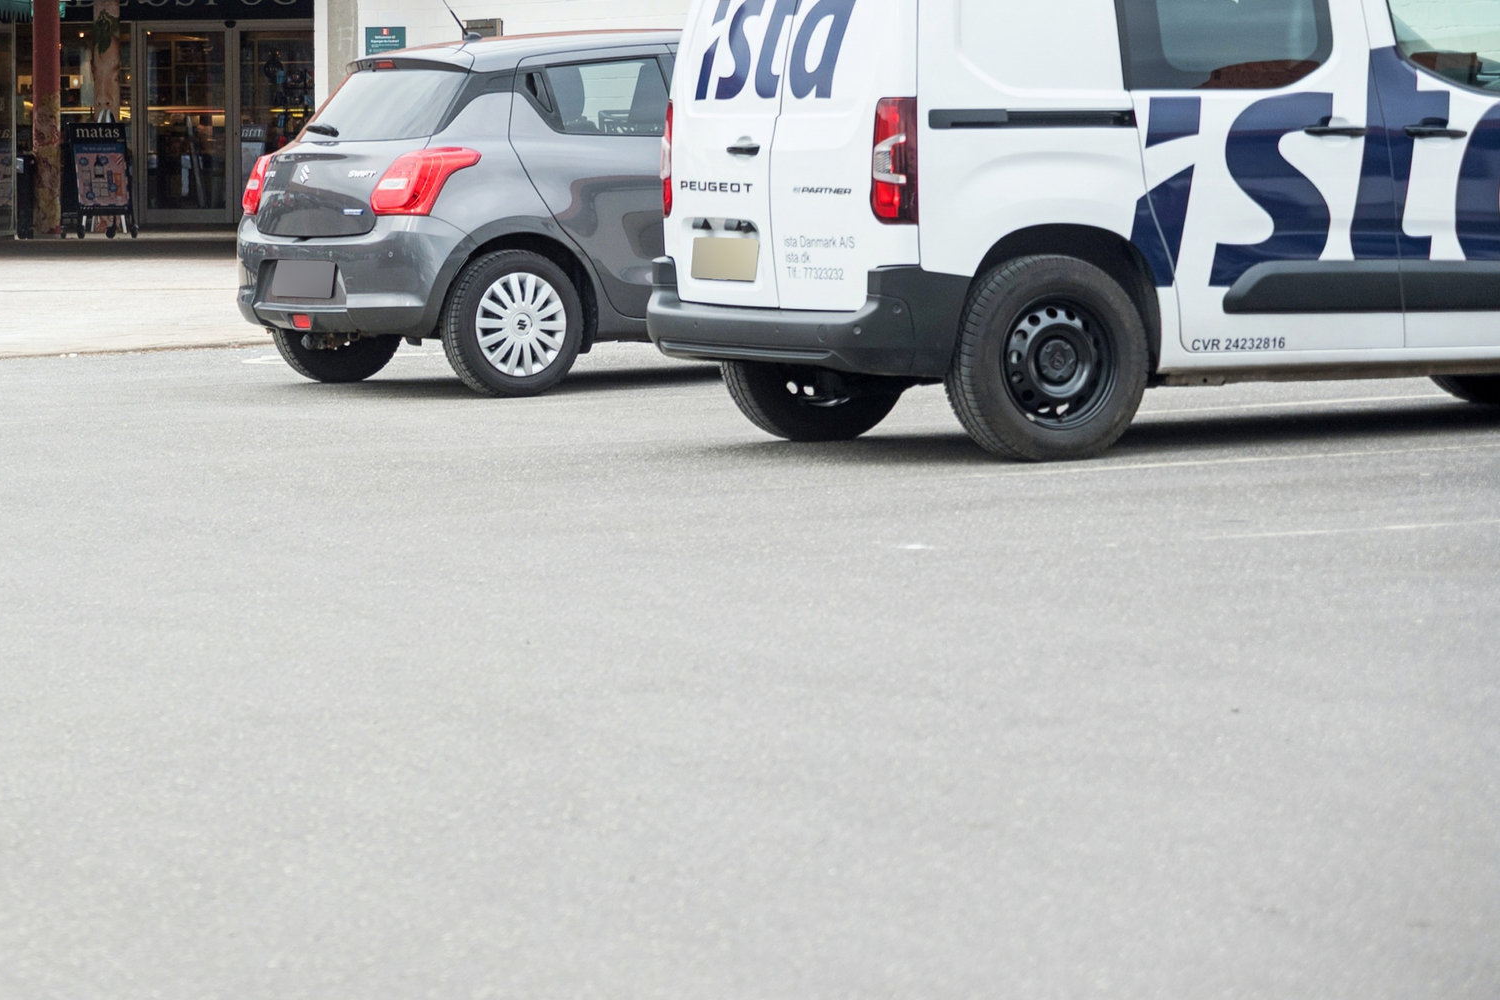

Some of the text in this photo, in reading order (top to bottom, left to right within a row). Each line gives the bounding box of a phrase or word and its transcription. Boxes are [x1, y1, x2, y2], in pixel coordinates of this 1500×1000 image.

[76, 127, 120, 138] matas
[347, 169, 377, 179] SWIFT
[680, 180, 753, 193] PEUGEOT
[801, 186, 852, 195] PARTNER
[784, 235, 856, 249] ista Danmark A/S
[785, 251, 811, 264] ista.dk
[803, 267, 844, 281] 77323232
[1191, 337, 1286, 351] CVR 24232816
